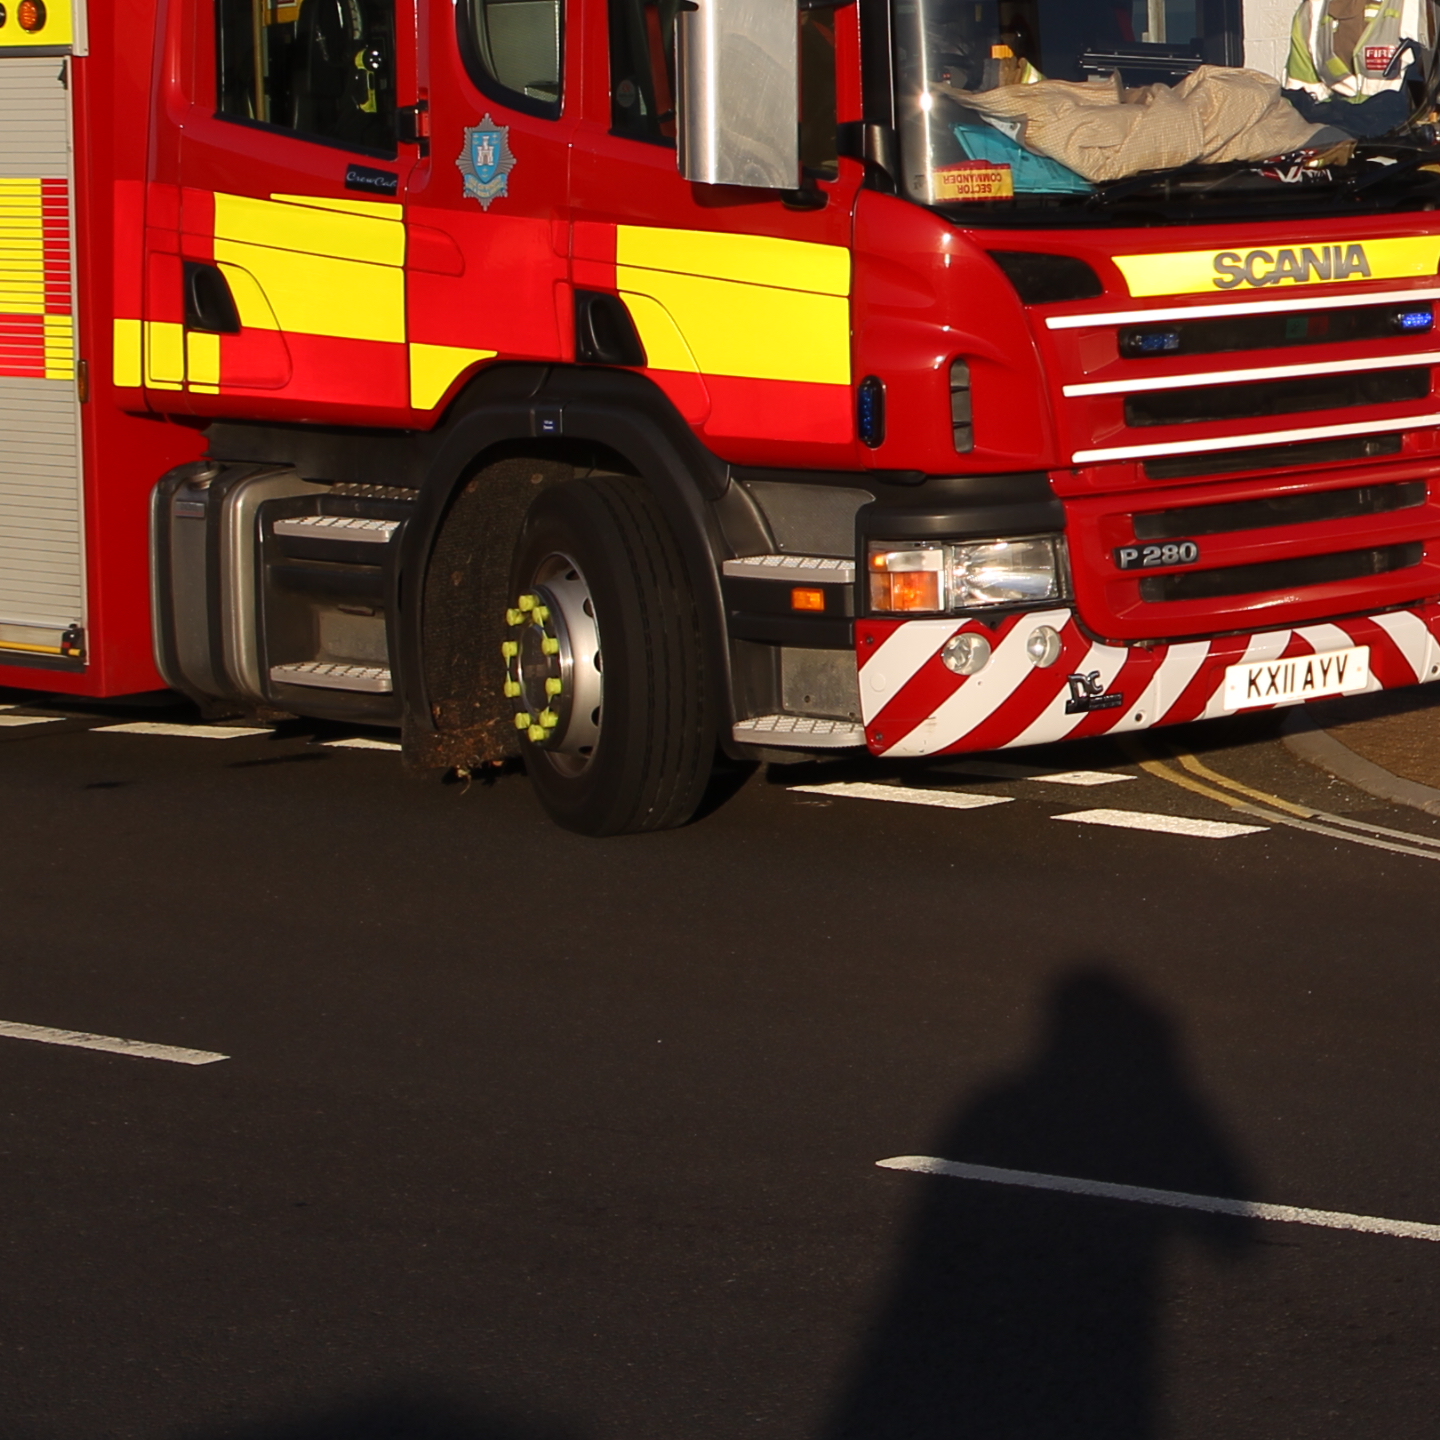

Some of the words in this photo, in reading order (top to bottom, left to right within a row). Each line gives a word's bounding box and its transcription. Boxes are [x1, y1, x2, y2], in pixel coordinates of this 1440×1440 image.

[943, 173, 1002, 184] COMMANDER
[957, 184, 992, 194] SECTOR
[1212, 244, 1372, 290] SCANIA
[1120, 548, 1138, 569] P
[1142, 542, 1197, 567] 280
[1247, 663, 1295, 699] KX11
[1302, 654, 1348, 691] AYV
